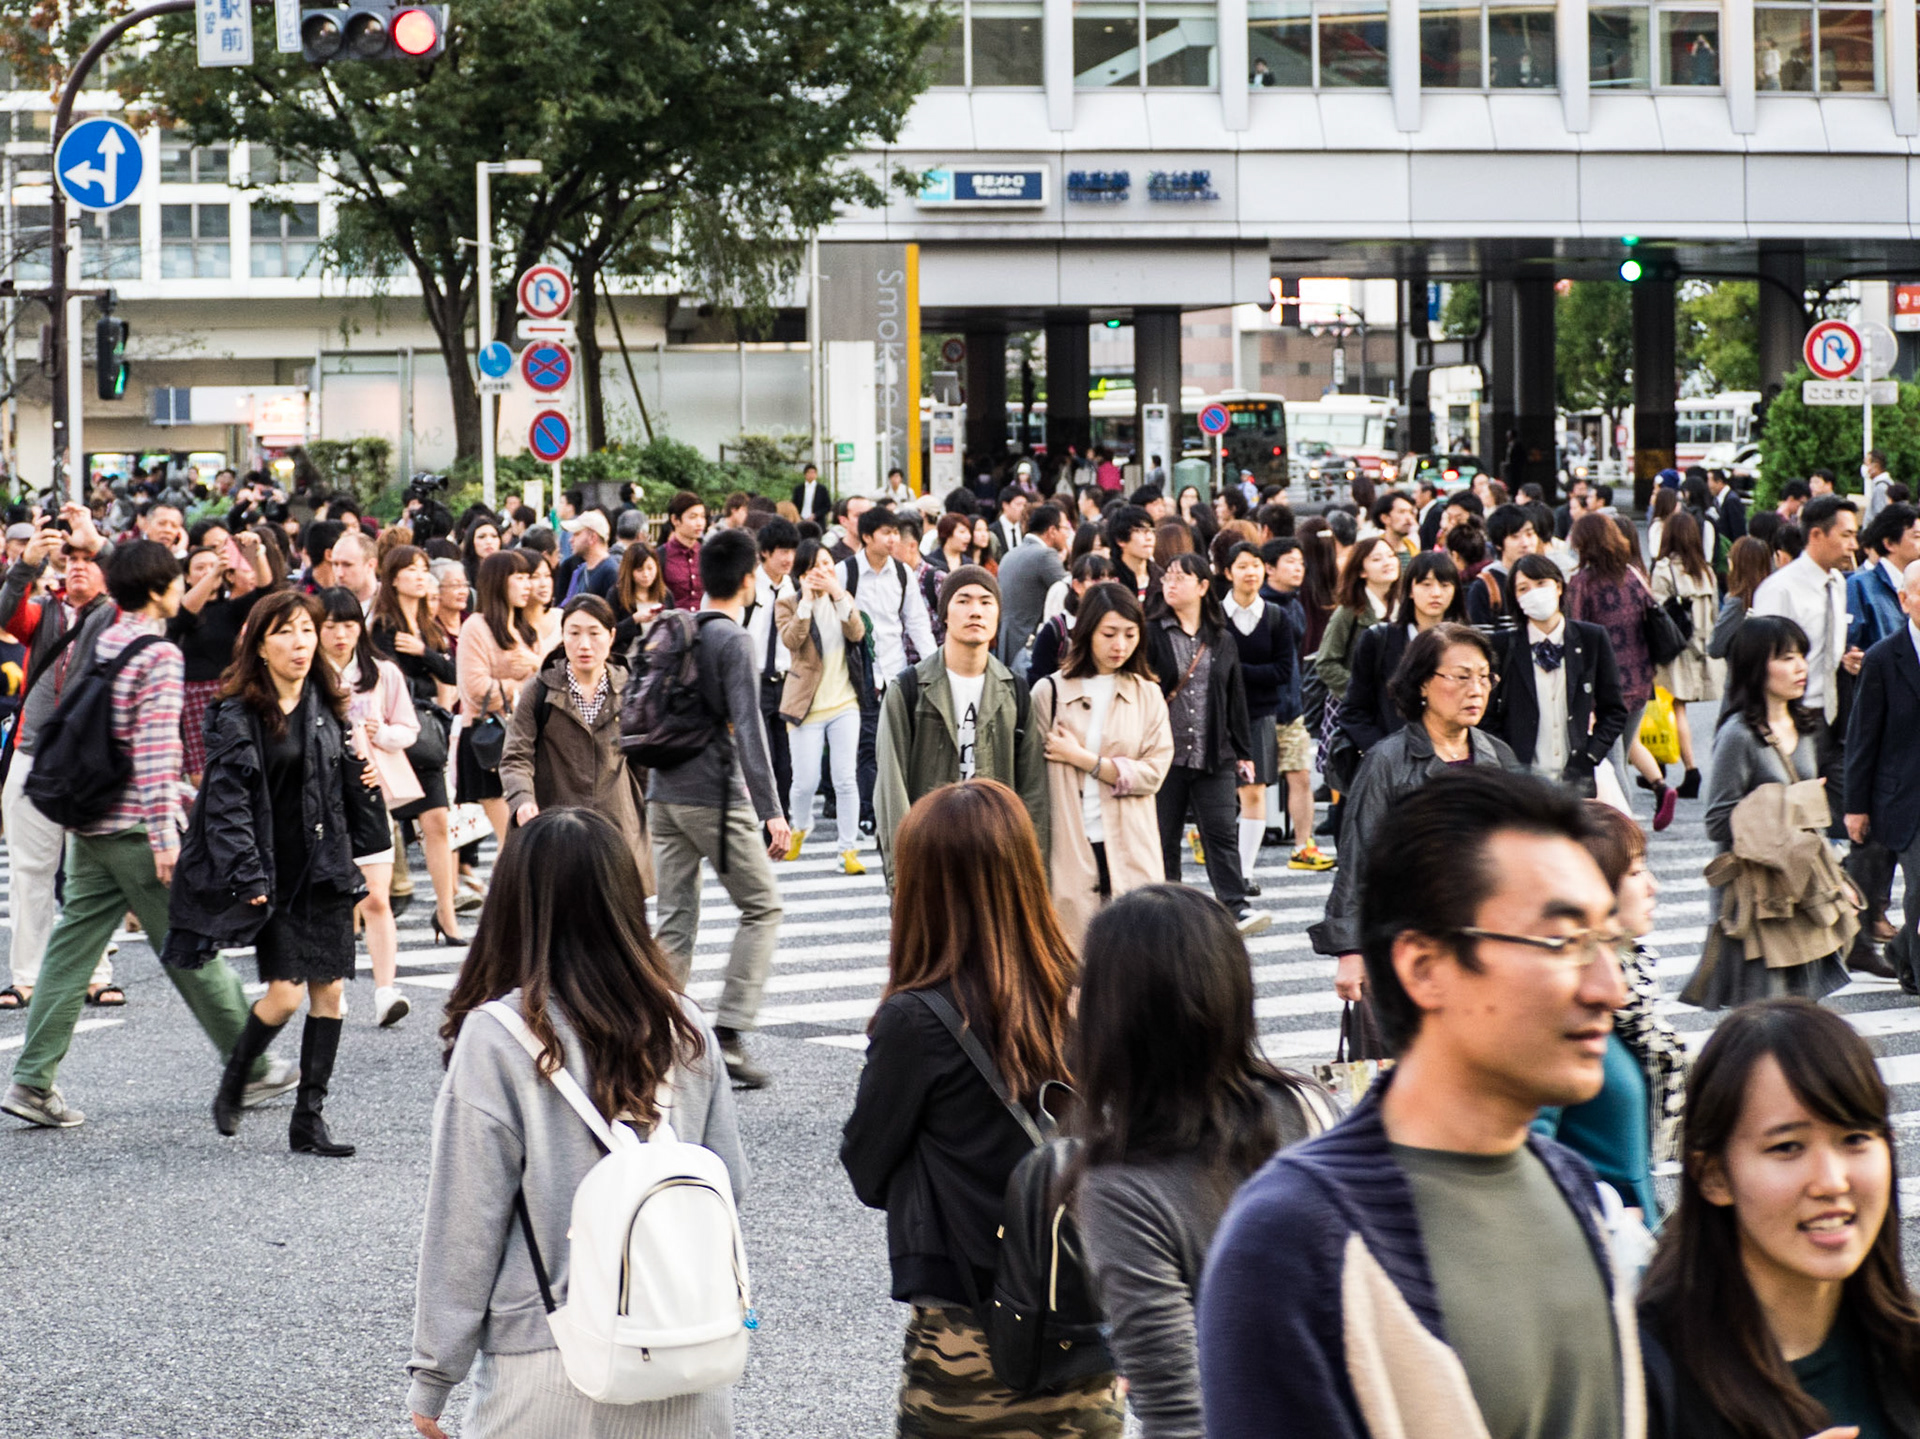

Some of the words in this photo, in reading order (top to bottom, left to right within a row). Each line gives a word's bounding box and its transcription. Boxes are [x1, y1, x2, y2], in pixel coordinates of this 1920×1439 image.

[220, 0, 243, 52] 駅前
[971, 174, 1026, 188] 東京メトロ
[876, 269, 904, 408] Smokg
[1808, 387, 1859, 401] ここまで
